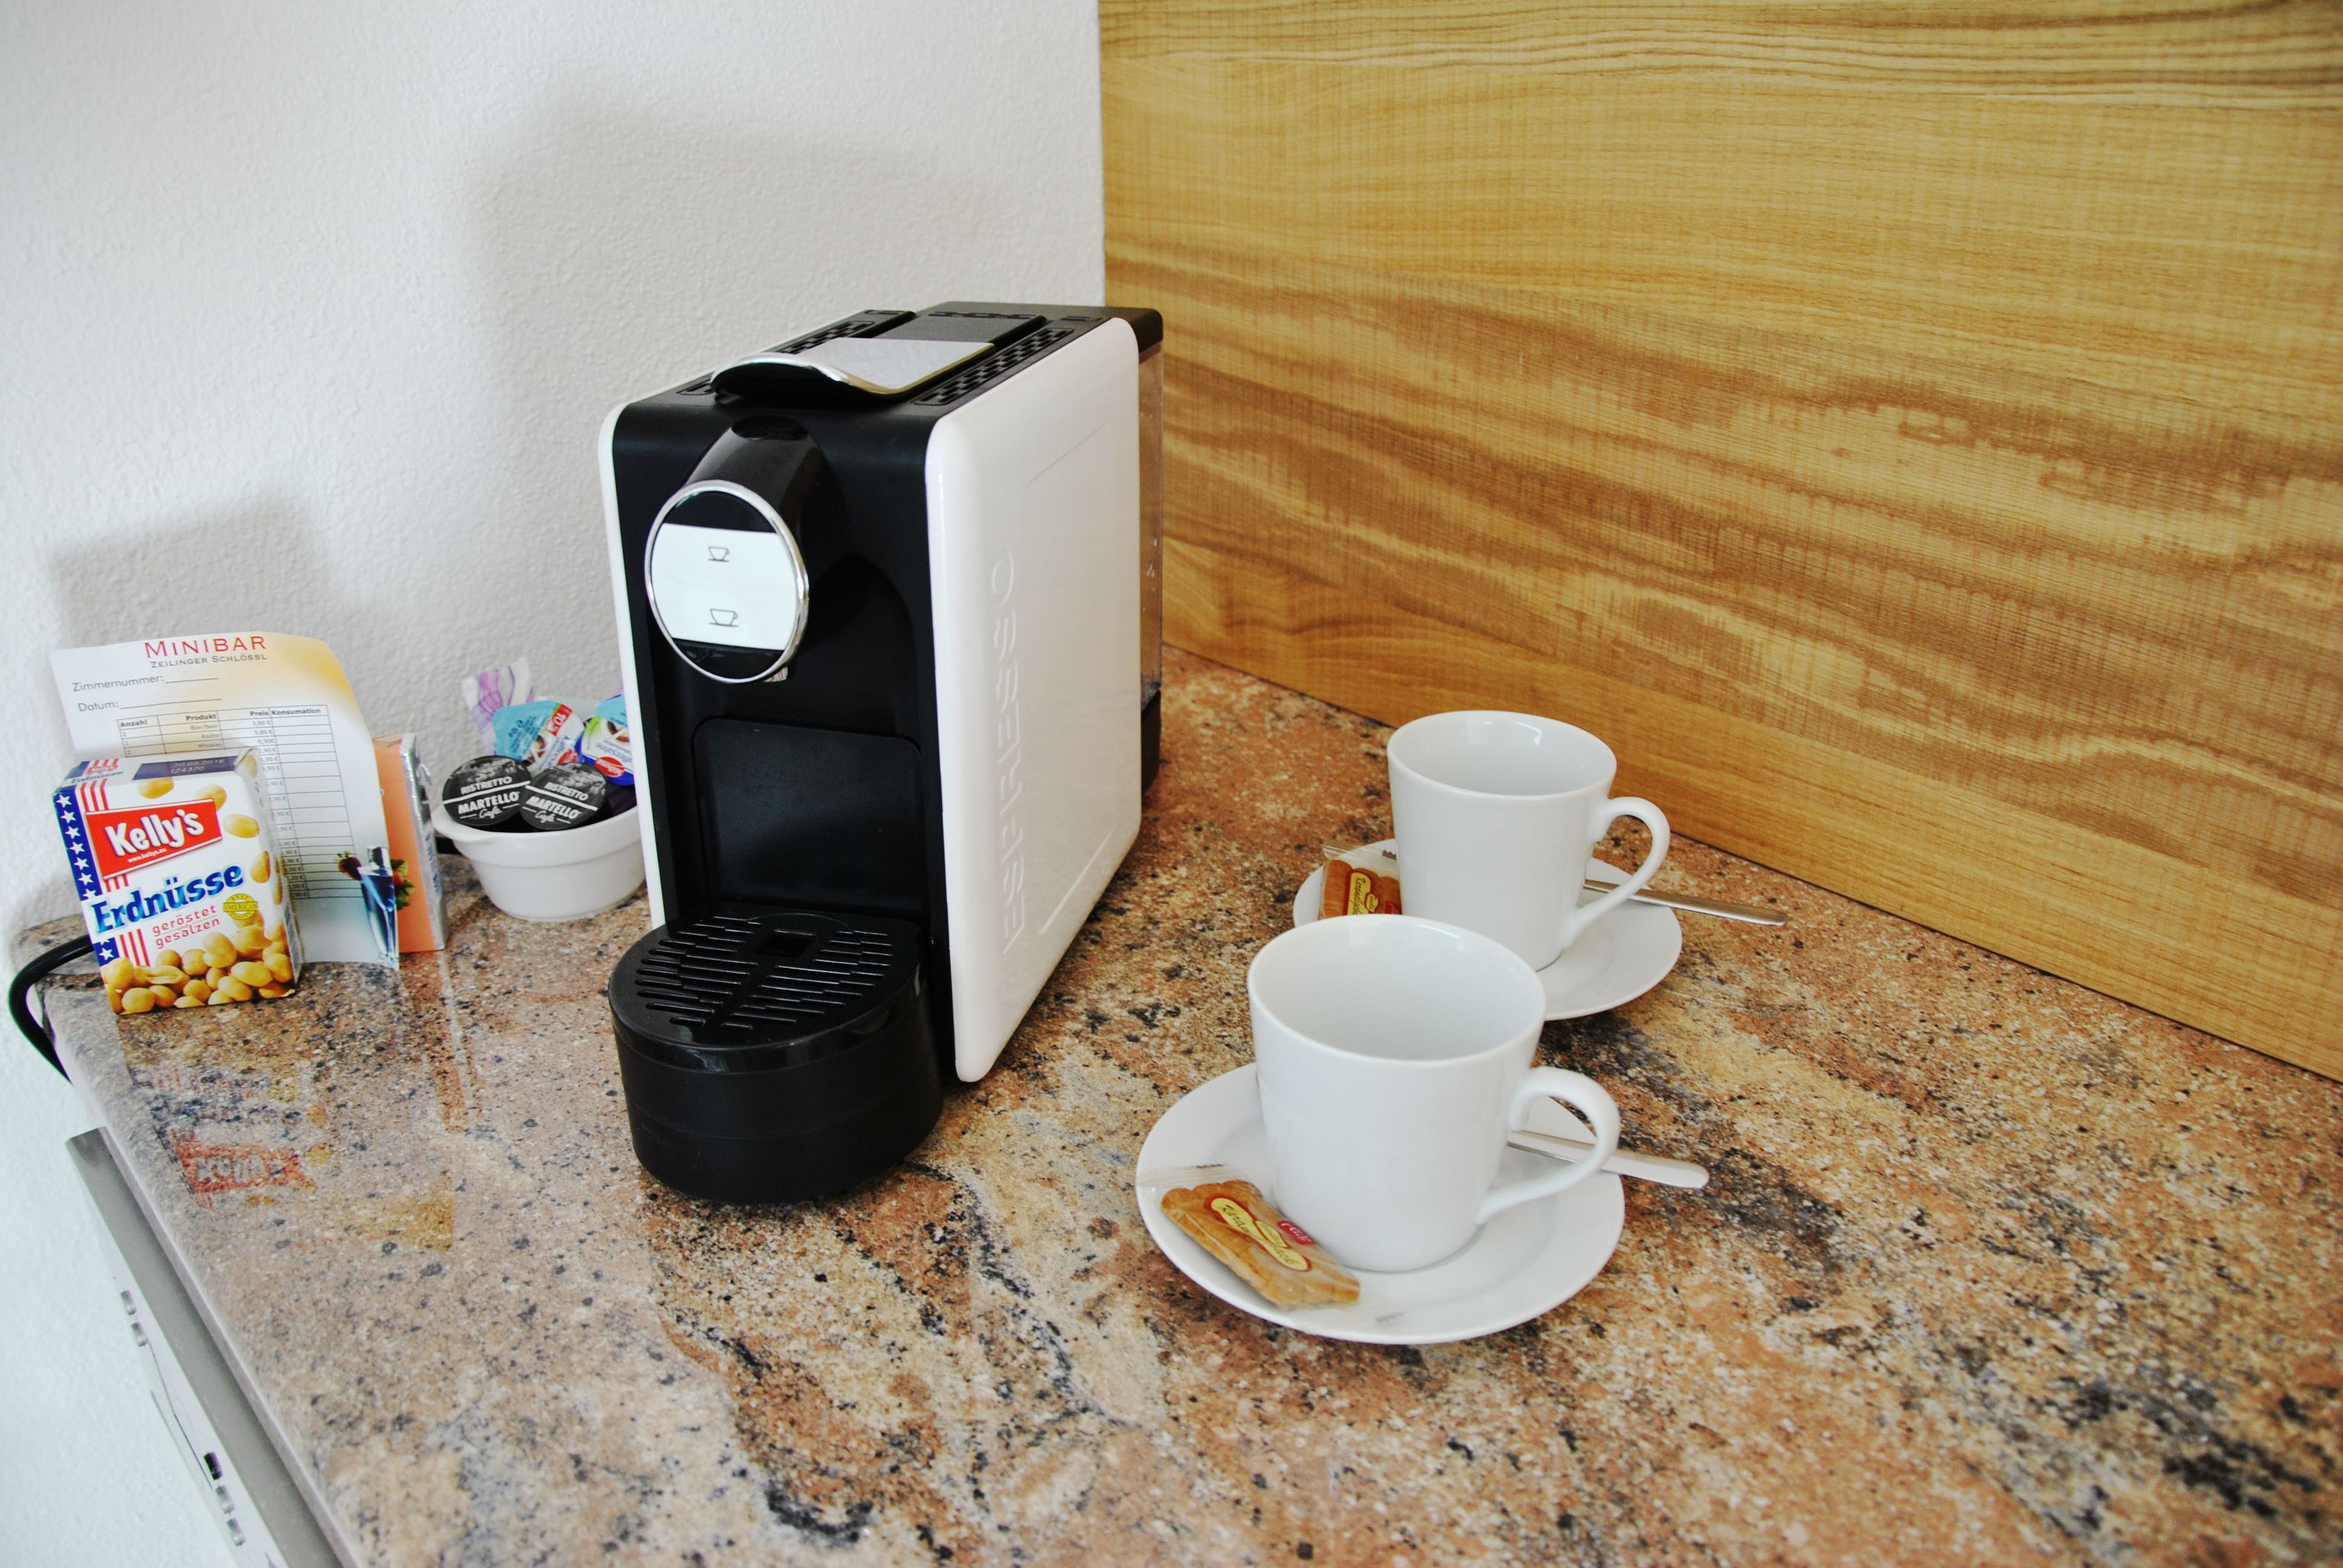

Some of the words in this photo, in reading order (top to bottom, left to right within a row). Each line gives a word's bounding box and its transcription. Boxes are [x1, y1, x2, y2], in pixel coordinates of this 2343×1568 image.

[144, 636, 267, 659] MINIBAR
[150, 657, 208, 668] ZEILINGER
[212, 652, 267, 664] SCHLÖSSL
[73, 675, 164, 692] Zimmernummer:
[77, 701, 119, 712] Datum:
[120, 719, 148, 728] Anzahl
[991, 549, 1025, 954] ESPRESSO
[461, 776, 513, 794] RISTRETTO
[544, 781, 589, 802] RISTRETTO
[458, 791, 519, 815] MARTELLO
[526, 796, 580, 820] MARTELLO
[104, 808, 204, 857] Kelly's
[91, 865, 244, 933] Erdnüsse
[153, 905, 217, 937] geröstet
[156, 918, 220, 949] gesalzen
